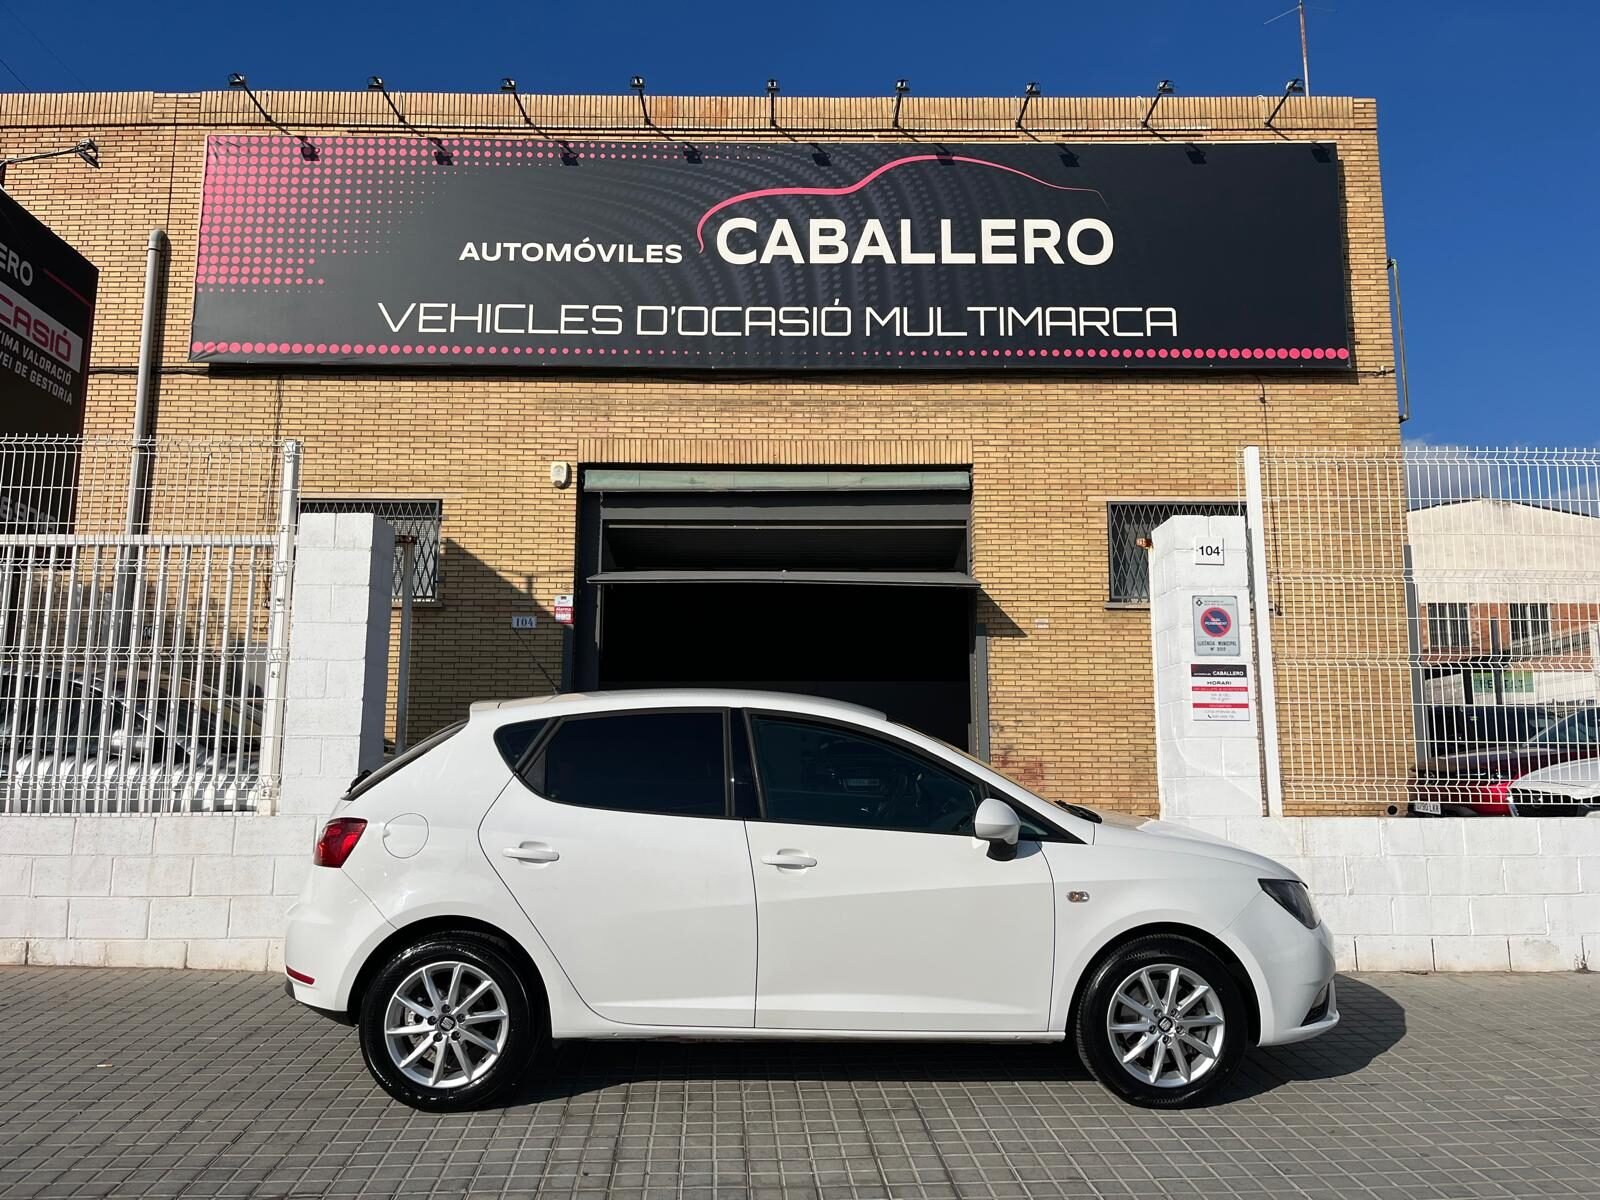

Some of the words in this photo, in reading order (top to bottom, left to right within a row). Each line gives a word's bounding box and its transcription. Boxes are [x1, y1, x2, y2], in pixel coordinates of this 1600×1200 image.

[459, 237, 683, 264] AUTOMÓVILES
[716, 217, 1115, 266] CABALLERO
[377, 302, 624, 336] VEHICLES
[636, 297, 852, 337] D'OCASIÓ
[865, 306, 1178, 337] MULTIMARCA
[14, 360, 29, 378] DE
[30, 369, 73, 406] GESTORIA
[22, 344, 72, 386] VALORACIÓ
[1199, 545, 1221, 556] 104
[516, 617, 533, 627] 104
